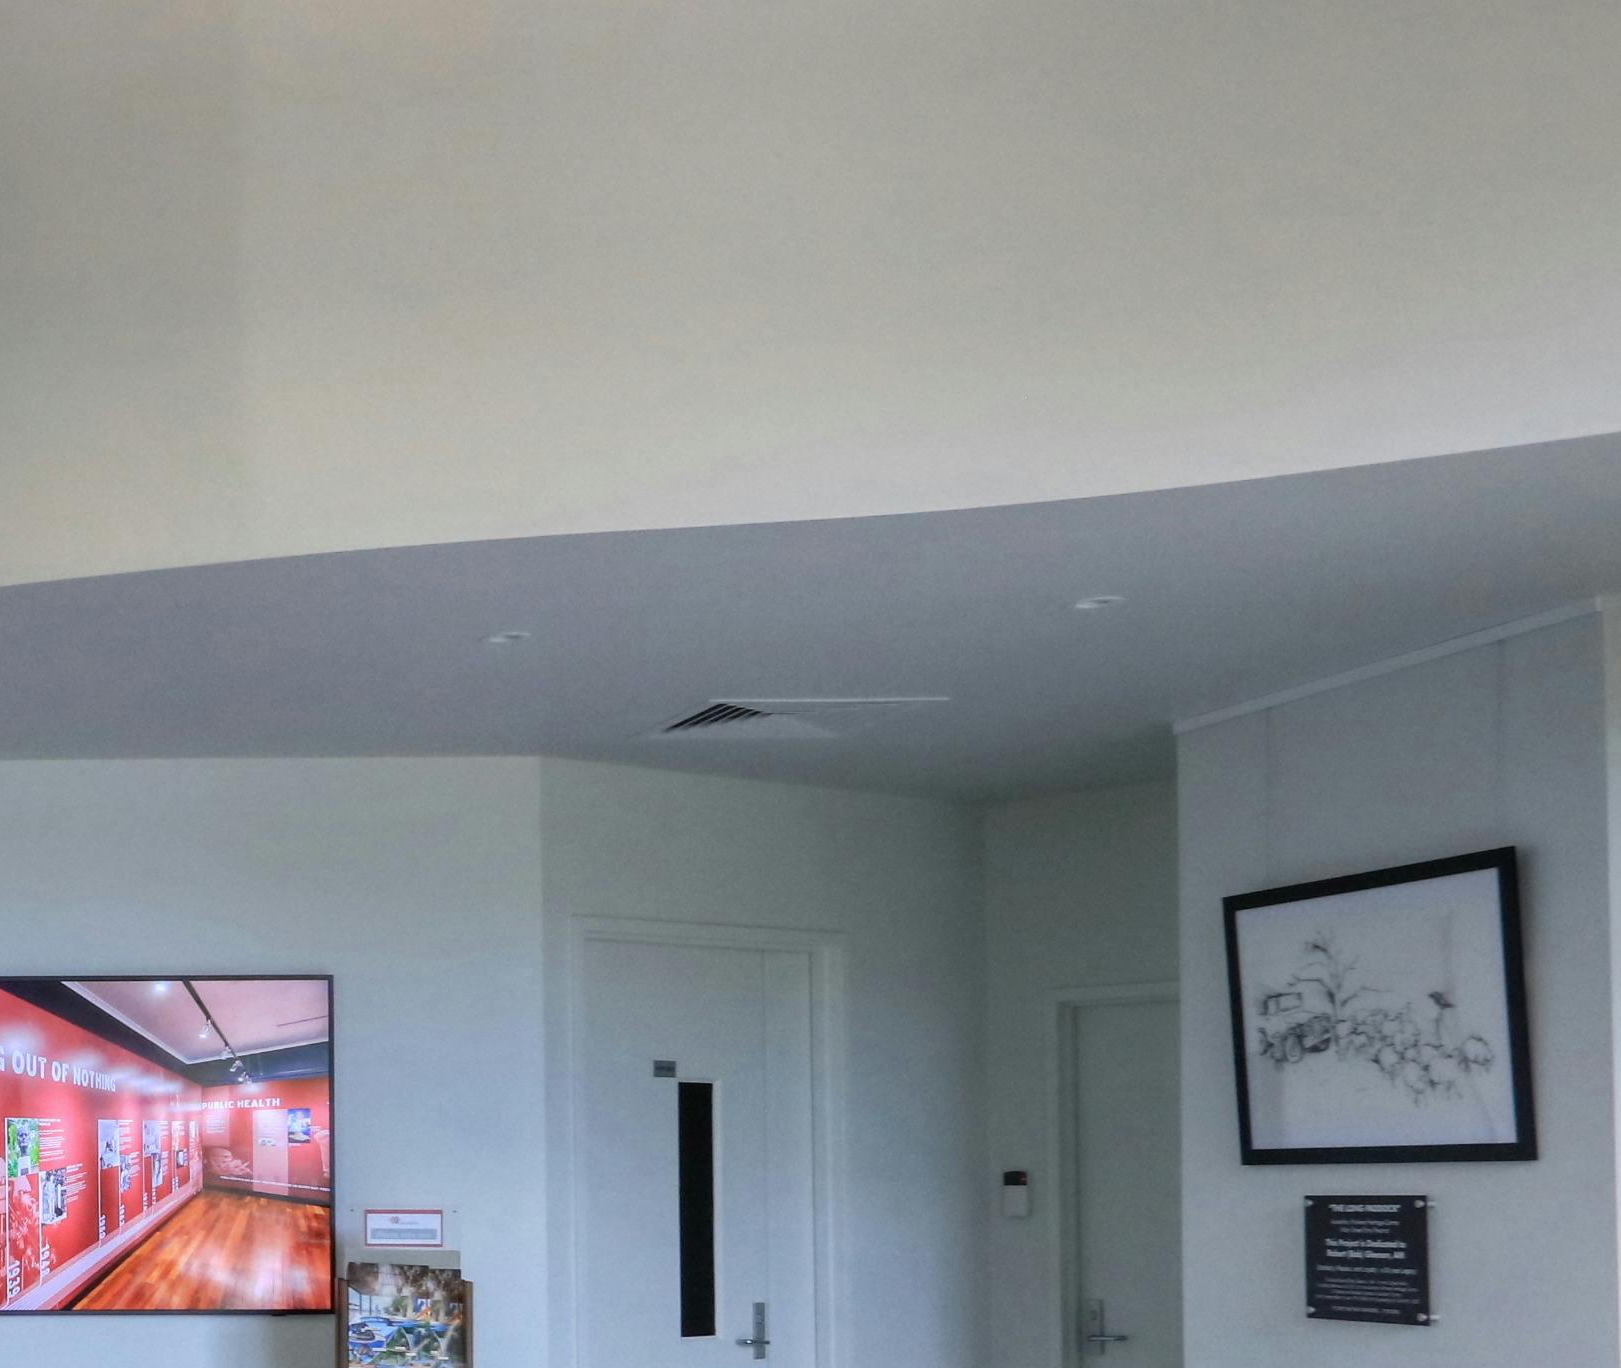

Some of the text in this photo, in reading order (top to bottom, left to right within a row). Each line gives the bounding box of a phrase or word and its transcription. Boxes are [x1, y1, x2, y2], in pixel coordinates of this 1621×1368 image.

[11, 1050, 47, 1080] OUT
[51, 1061, 70, 1084] OF
[73, 1066, 117, 1093] NOTHING
[202, 1097, 281, 1110] PUBLIC HEALTH
[8, 1259, 22, 1299] 1939
